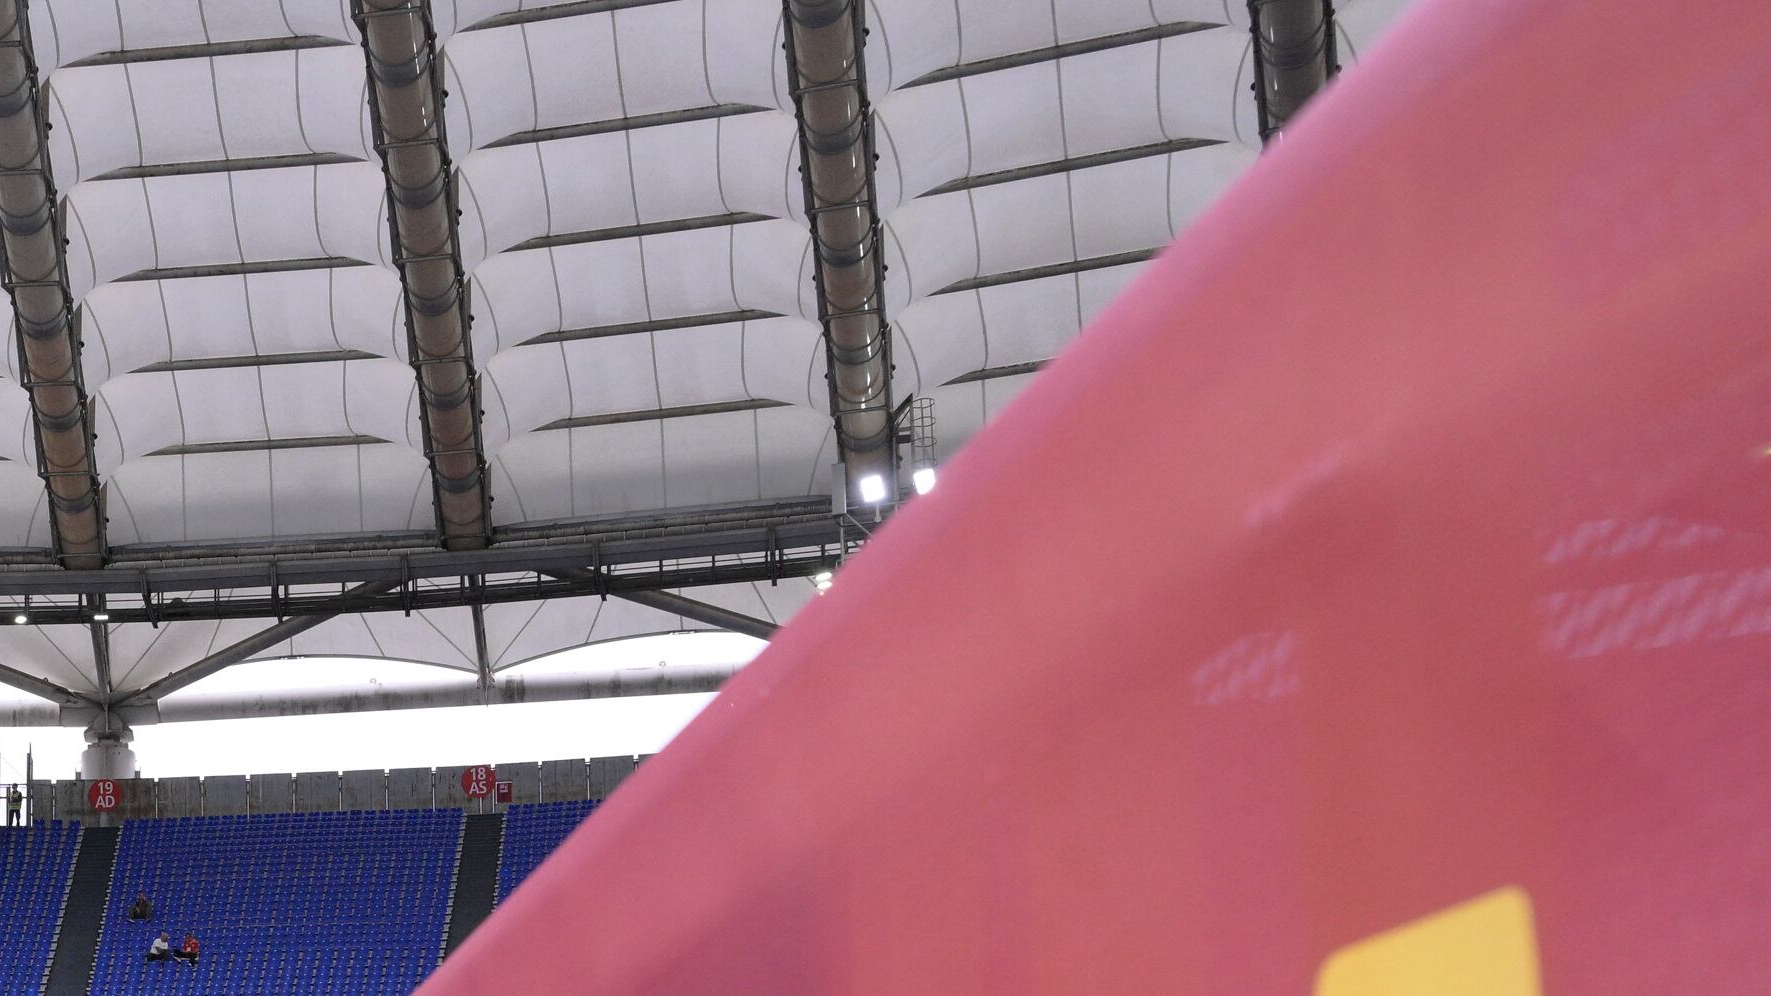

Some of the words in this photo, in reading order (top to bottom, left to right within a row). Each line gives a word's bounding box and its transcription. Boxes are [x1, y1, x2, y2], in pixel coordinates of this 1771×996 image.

[470, 767, 486, 780] 18
[97, 781, 114, 794] 19
[469, 781, 487, 794] AS
[95, 795, 116, 808] AD
